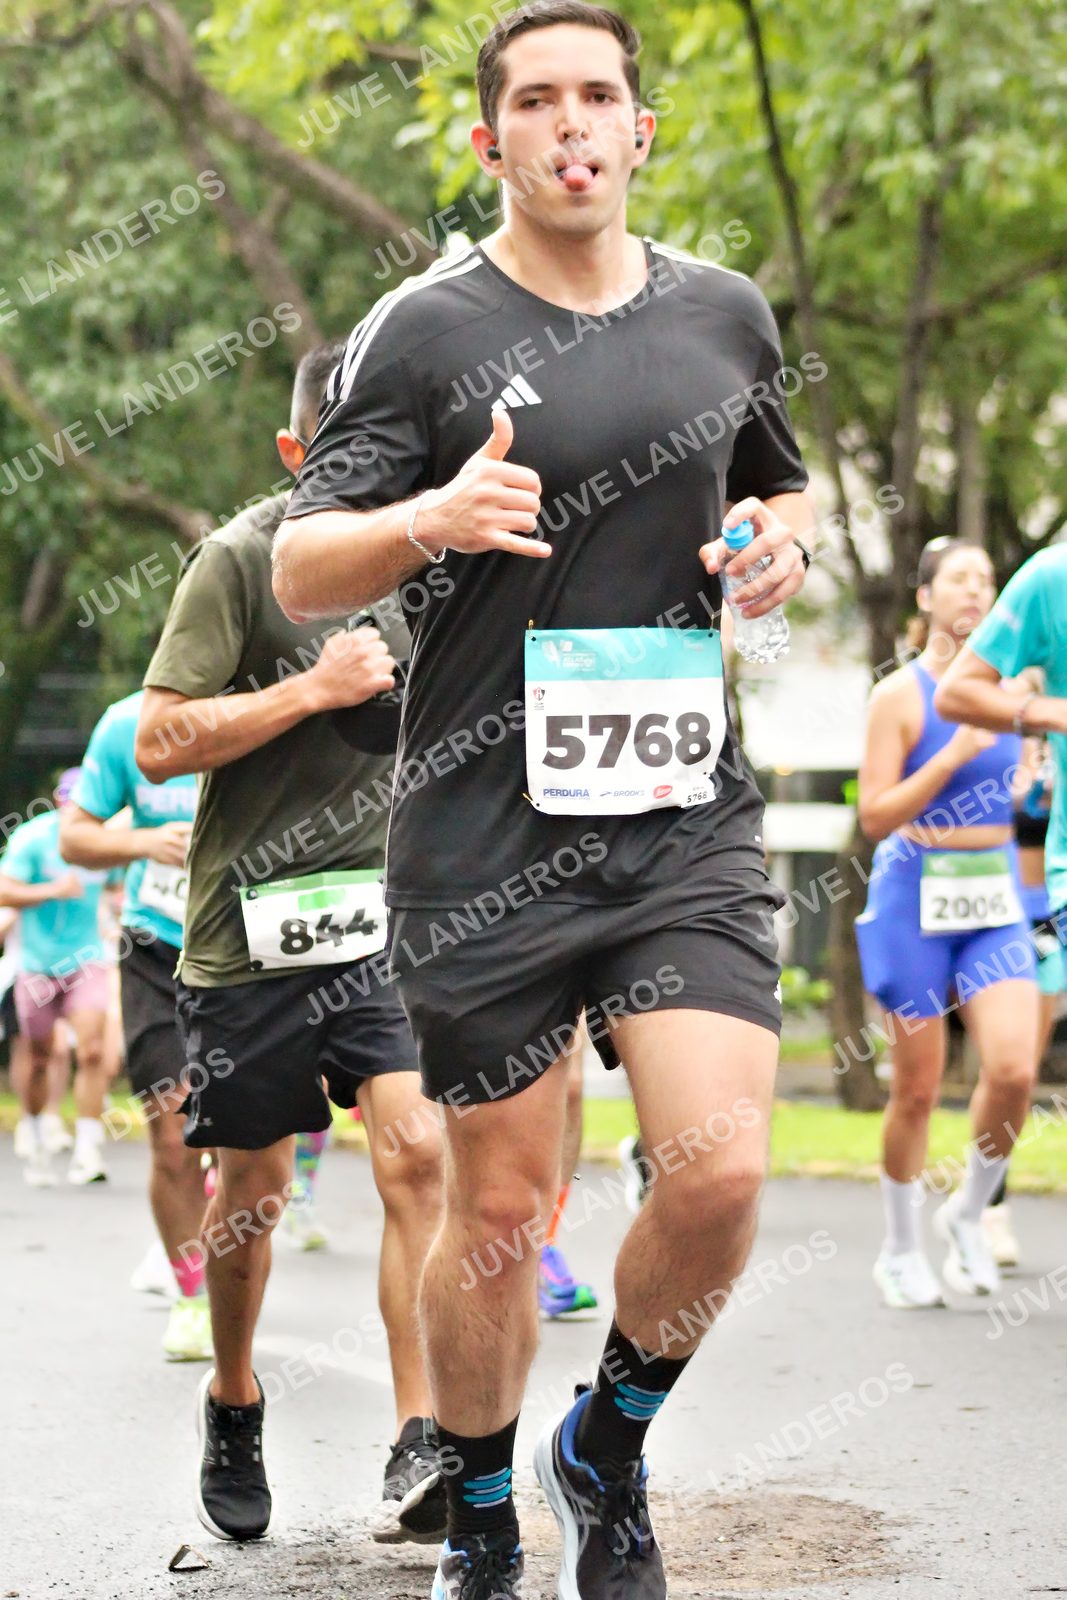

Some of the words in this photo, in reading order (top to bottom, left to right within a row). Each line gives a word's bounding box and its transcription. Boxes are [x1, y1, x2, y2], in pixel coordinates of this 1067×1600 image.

[541, 711, 712, 770] 5768
[543, 788, 590, 798] PERDURA
[687, 791, 708, 804] 5768
[932, 893, 1009, 920] 2006
[280, 907, 378, 956] 844
